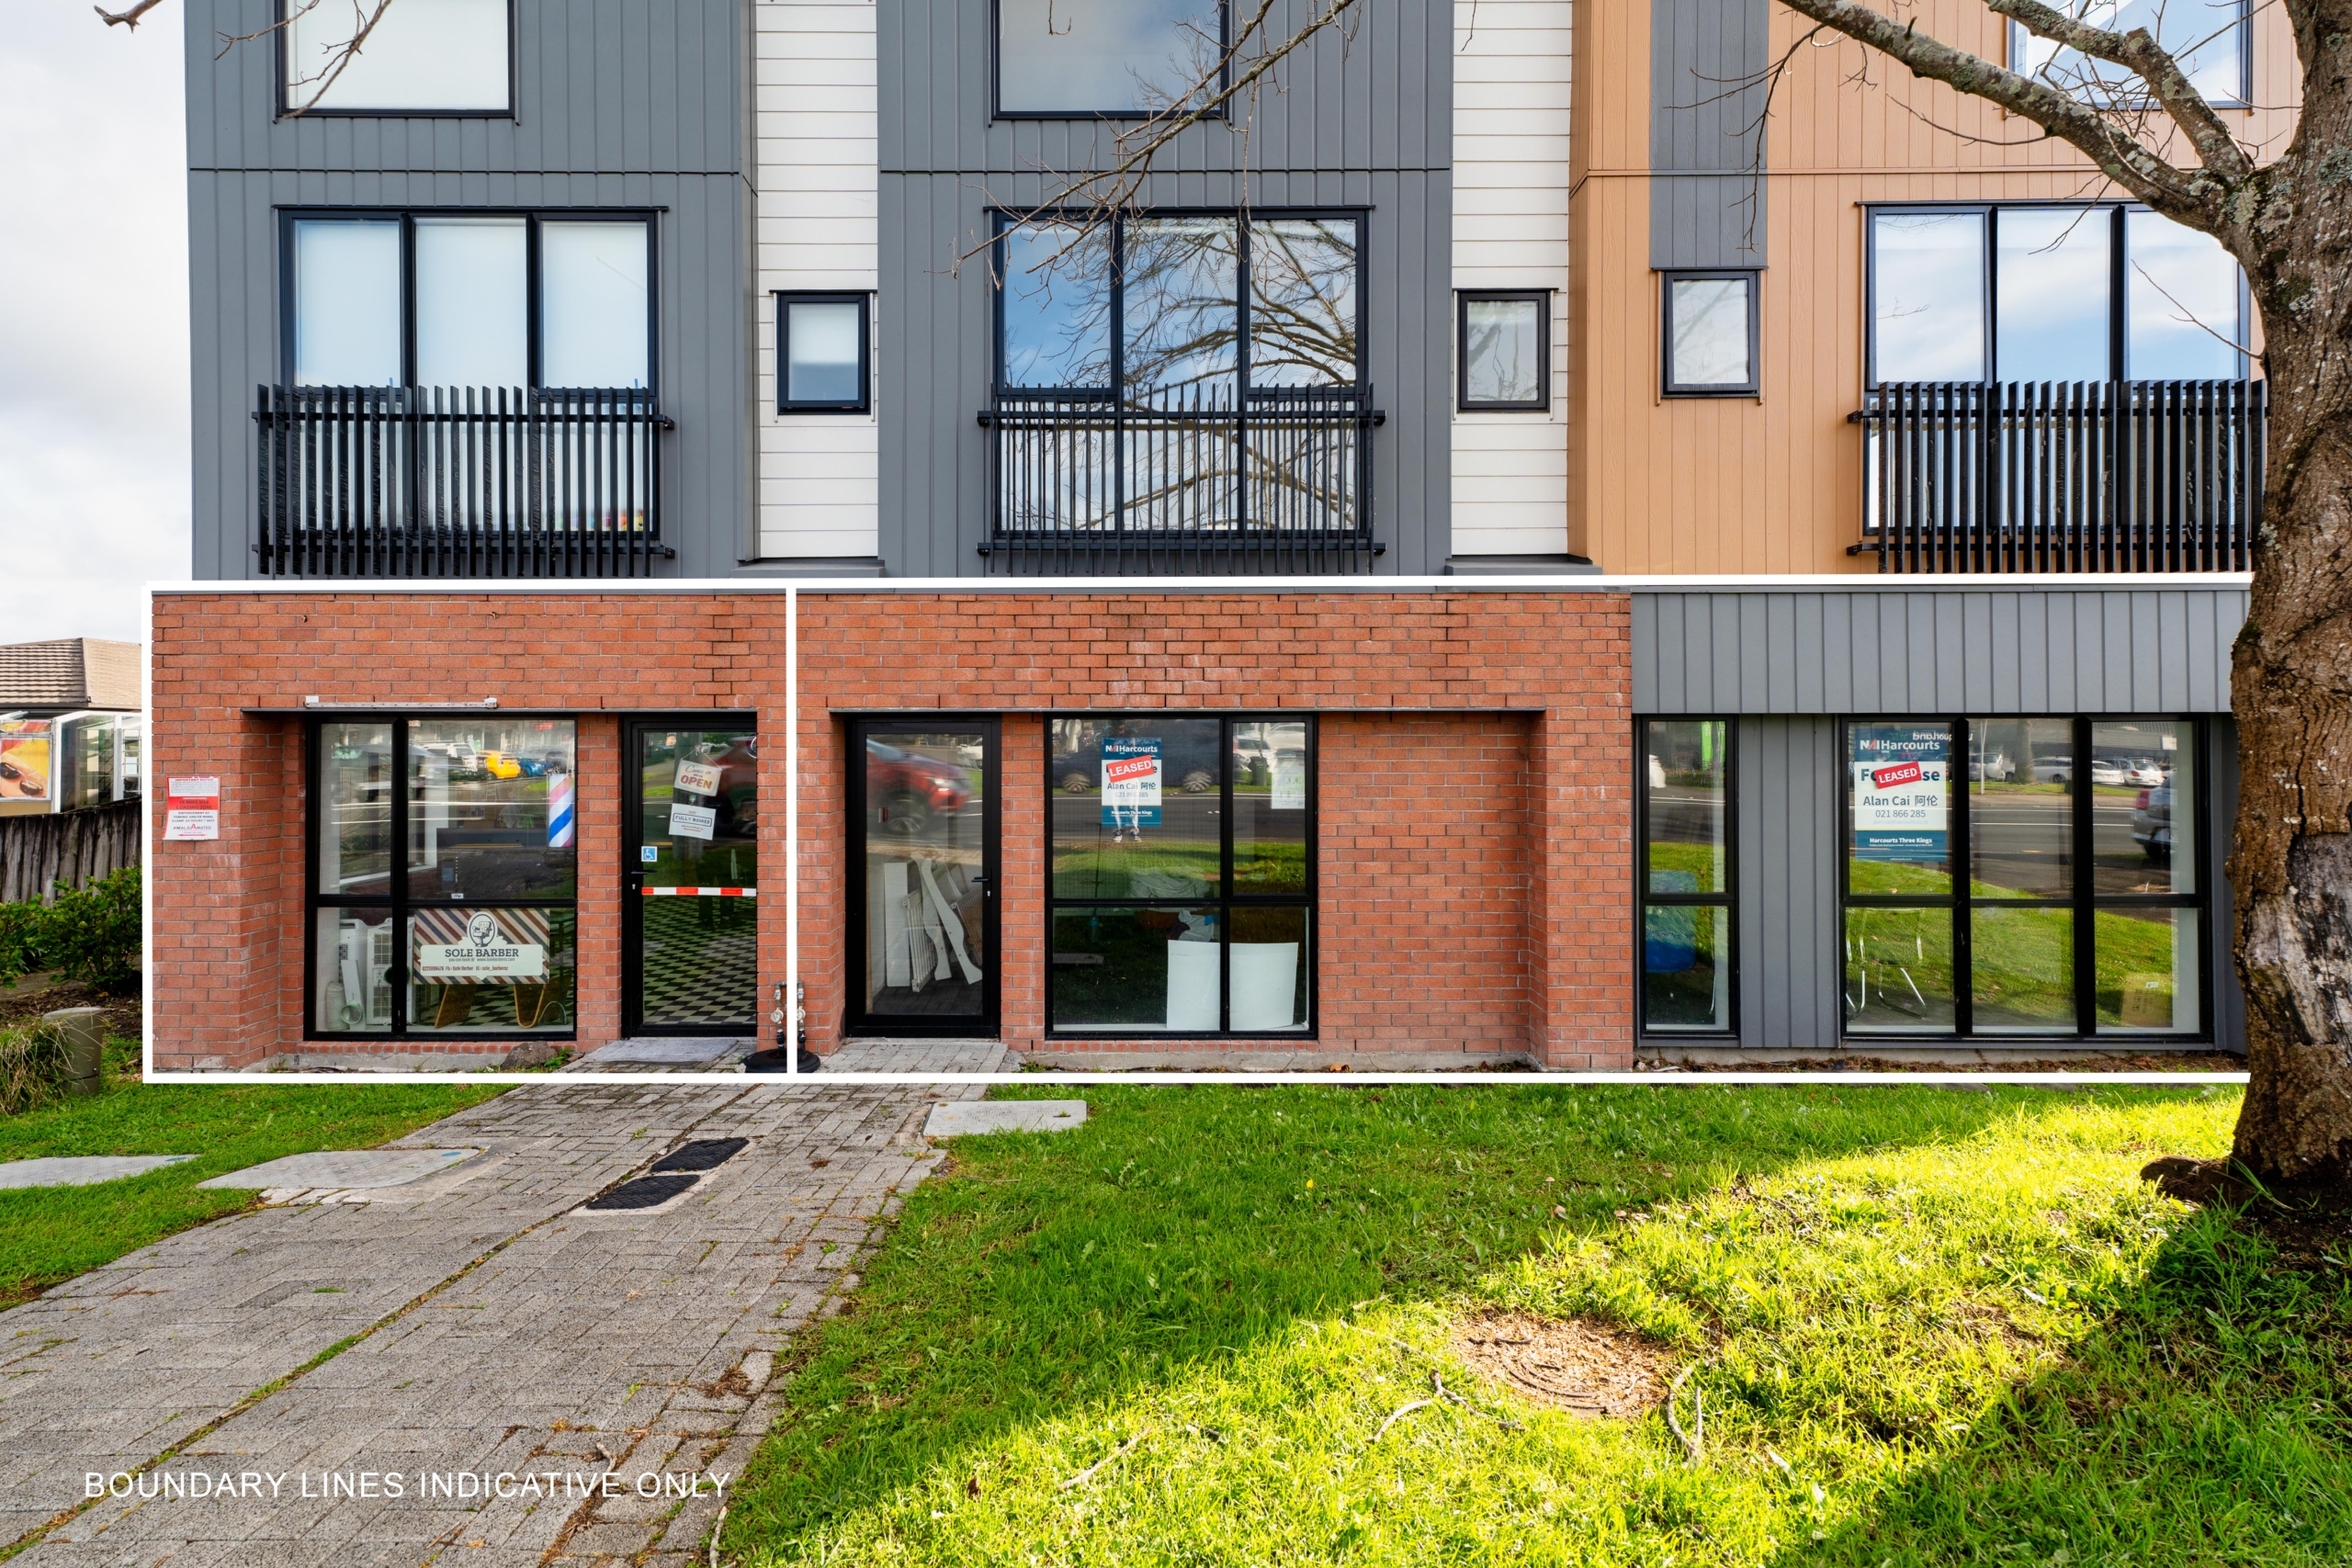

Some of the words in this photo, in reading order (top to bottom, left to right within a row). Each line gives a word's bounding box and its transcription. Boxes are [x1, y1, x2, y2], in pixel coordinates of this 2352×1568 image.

[1881, 739, 1940, 750] Harcourts
[1109, 760, 1152, 777] LEASED
[680, 774, 713, 789] OPEN
[1878, 767, 1917, 784] LEASED
[1863, 795, 1889, 807] Alan
[1892, 795, 1910, 807] Cai
[1915, 795, 1939, 807] 阿伦
[1875, 809, 1891, 818] 021
[1893, 809, 1909, 818] 866
[1910, 809, 1926, 818] 285
[445, 949, 473, 957] SOLE
[475, 949, 519, 957] BARBER
